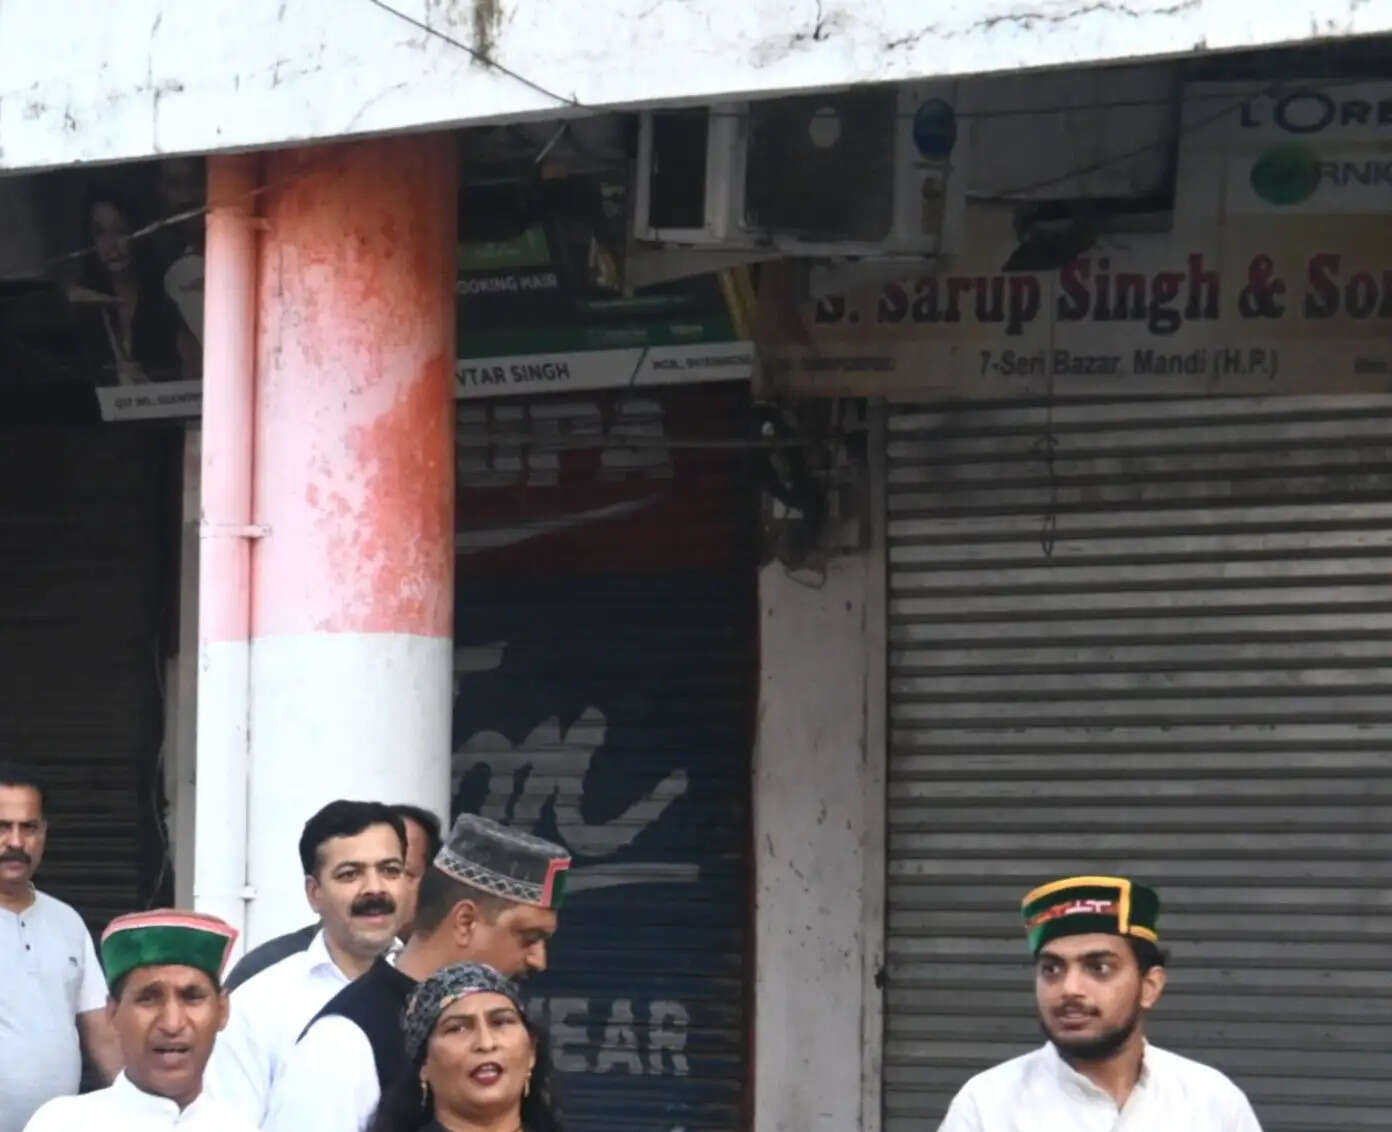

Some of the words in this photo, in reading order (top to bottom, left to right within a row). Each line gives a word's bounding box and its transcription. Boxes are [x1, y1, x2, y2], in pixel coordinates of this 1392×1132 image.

[877, 274, 1040, 335] Sarup
[1056, 252, 1221, 335] Singh
[1238, 253, 1287, 319] &
[455, 366, 507, 386] VTAR
[510, 362, 571, 383] SINGH
[1133, 348, 1208, 376] Mandi
